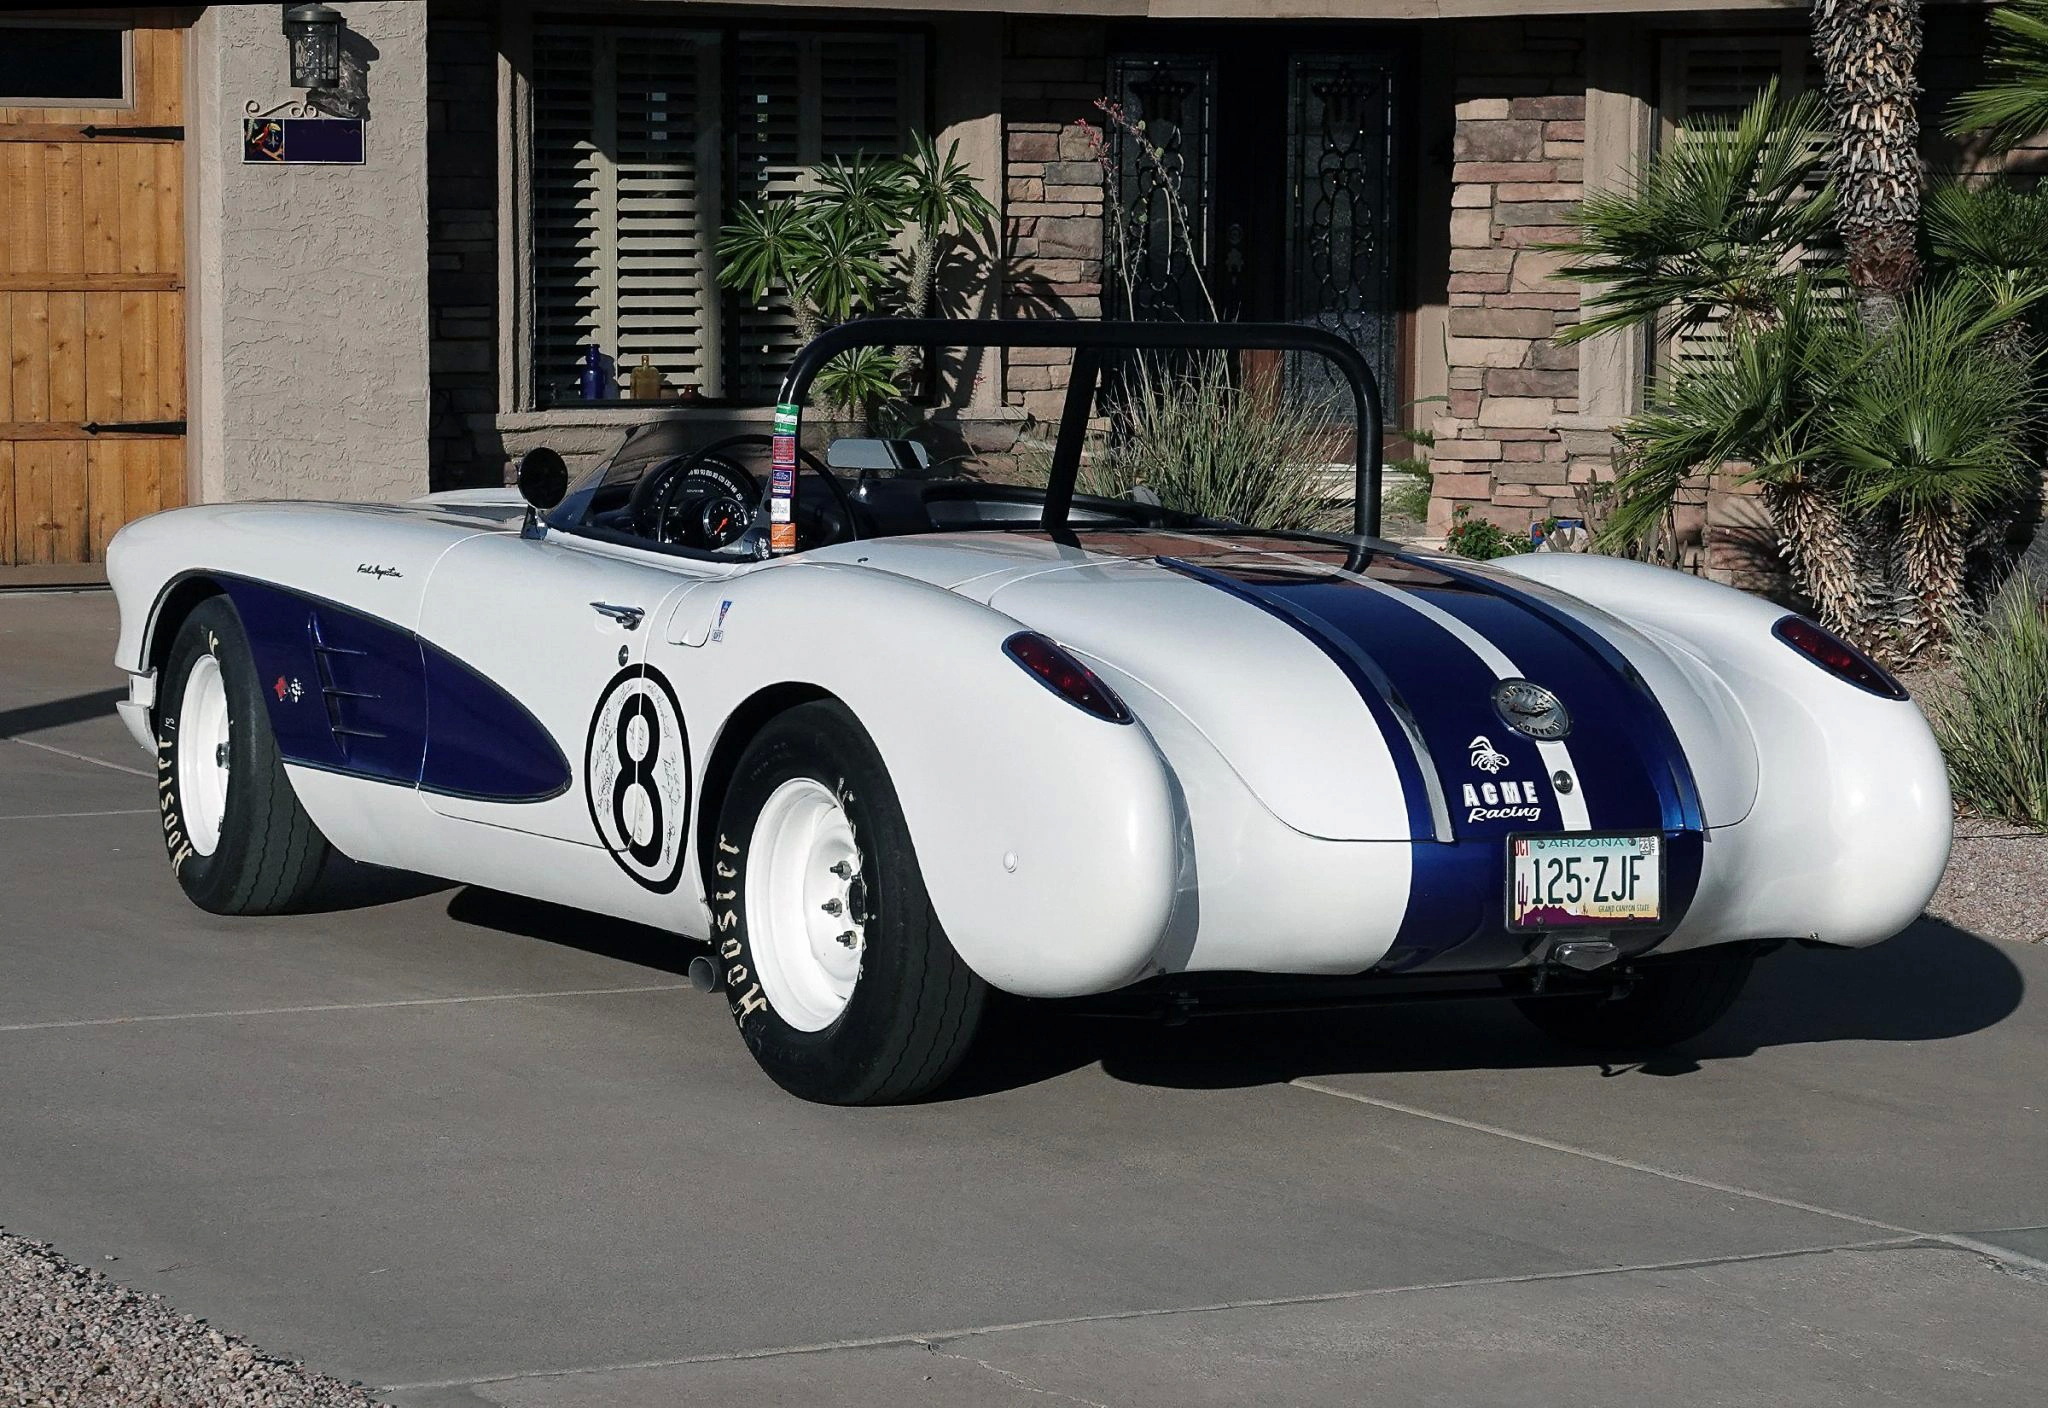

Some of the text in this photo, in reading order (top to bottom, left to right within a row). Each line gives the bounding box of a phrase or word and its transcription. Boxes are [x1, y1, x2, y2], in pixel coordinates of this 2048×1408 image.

[612, 692, 664, 868] 8
[1462, 781, 1539, 807] ACME
[1467, 806, 1541, 823] Racing
[1548, 839, 1624, 848] ARIZONA
[1640, 841, 1650, 852] 23
[1599, 902, 1650, 913] GRAND CANYON STATE
